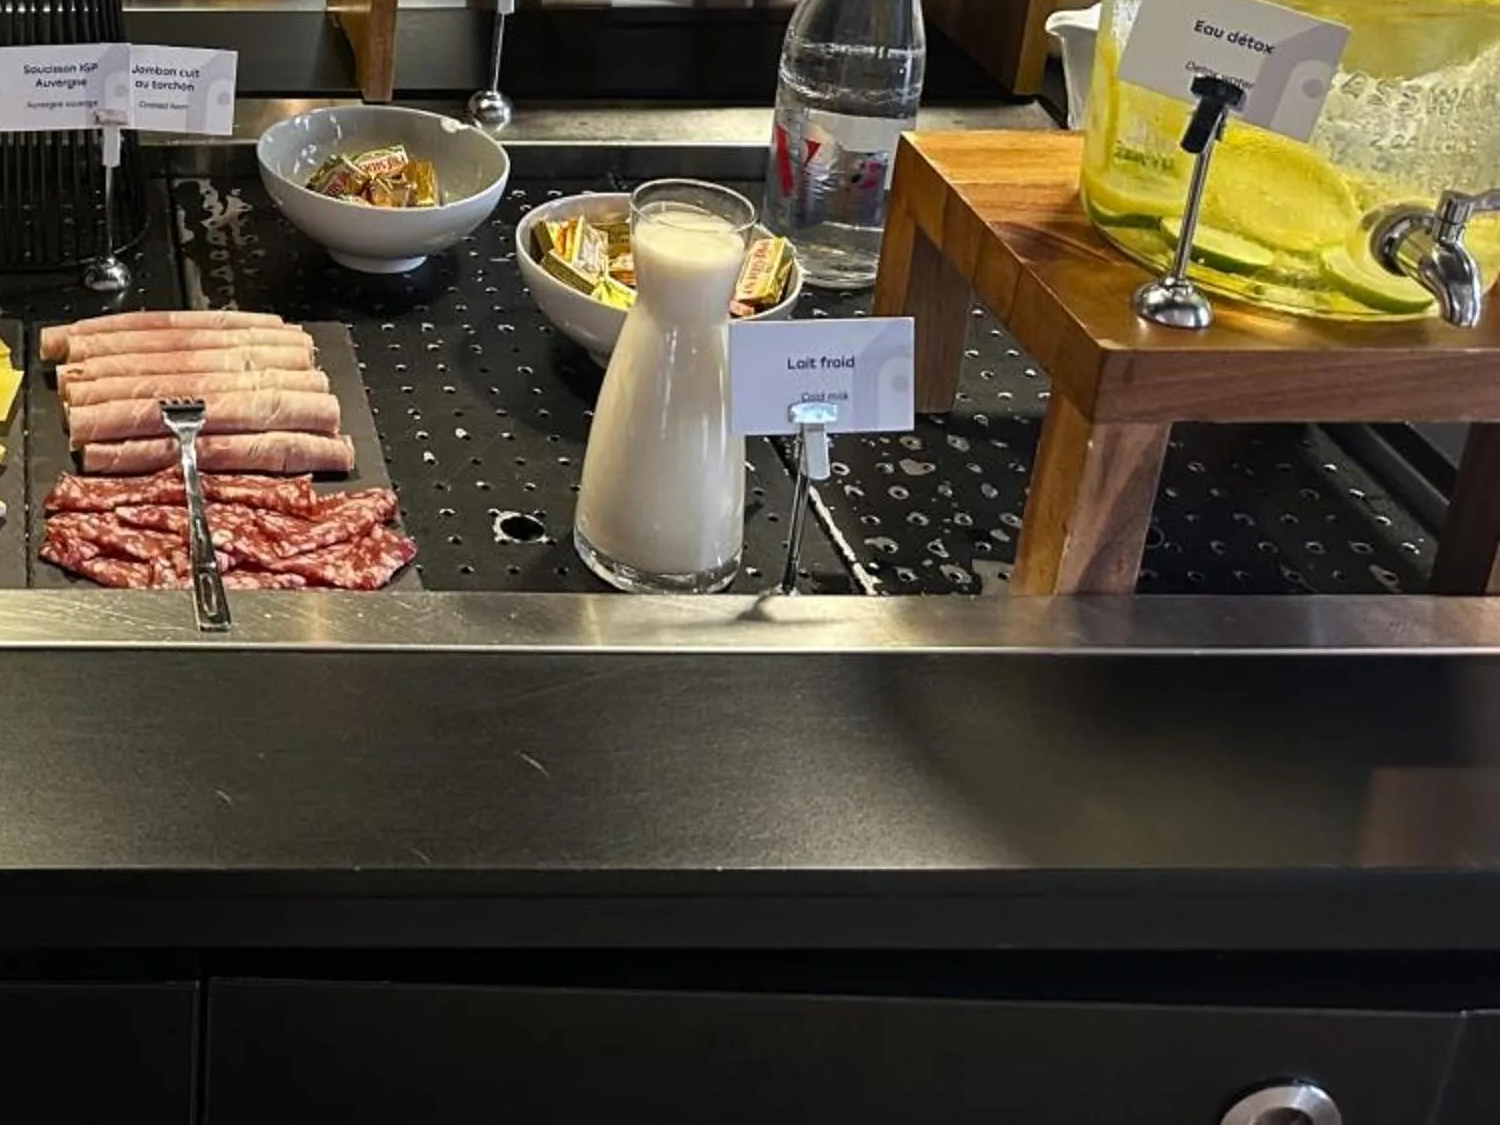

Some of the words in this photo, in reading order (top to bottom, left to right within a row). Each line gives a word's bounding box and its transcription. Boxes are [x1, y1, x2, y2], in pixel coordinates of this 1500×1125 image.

[1193, 19, 1225, 39] Eau
[1226, 30, 1276, 55] détox
[787, 356, 816, 370] Lait
[819, 355, 856, 369] froid
